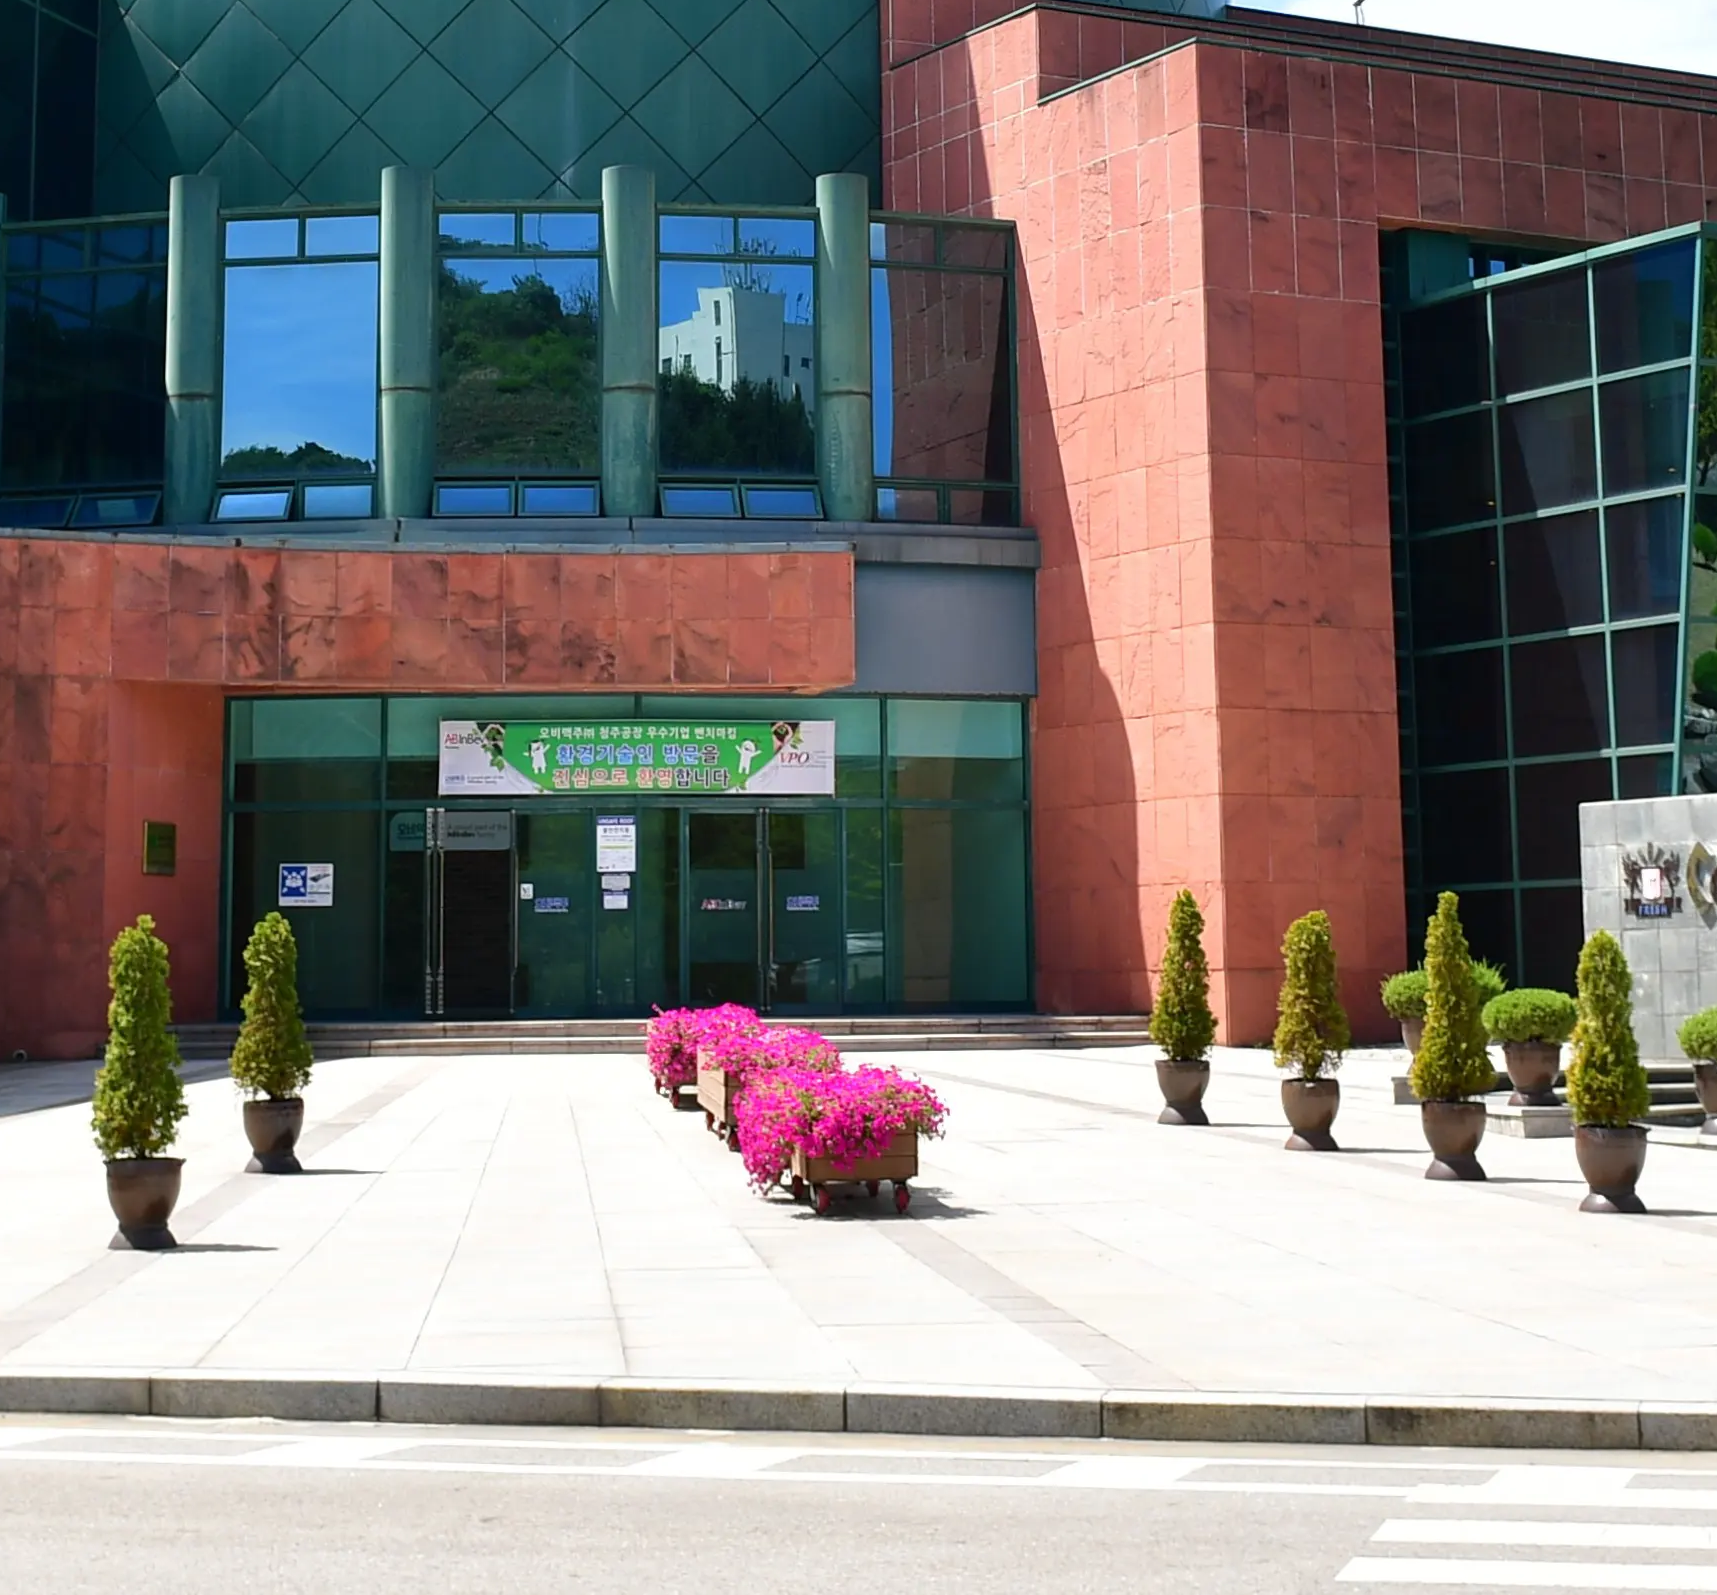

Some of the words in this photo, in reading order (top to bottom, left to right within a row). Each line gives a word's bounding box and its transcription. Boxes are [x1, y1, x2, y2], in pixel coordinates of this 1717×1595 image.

[556, 743, 653, 766] 환경기술인
[663, 743, 720, 766] 방문을
[780, 752, 809, 765] VPO
[552, 767, 629, 789] 진심으로
[636, 767, 730, 789] 환영합니다
